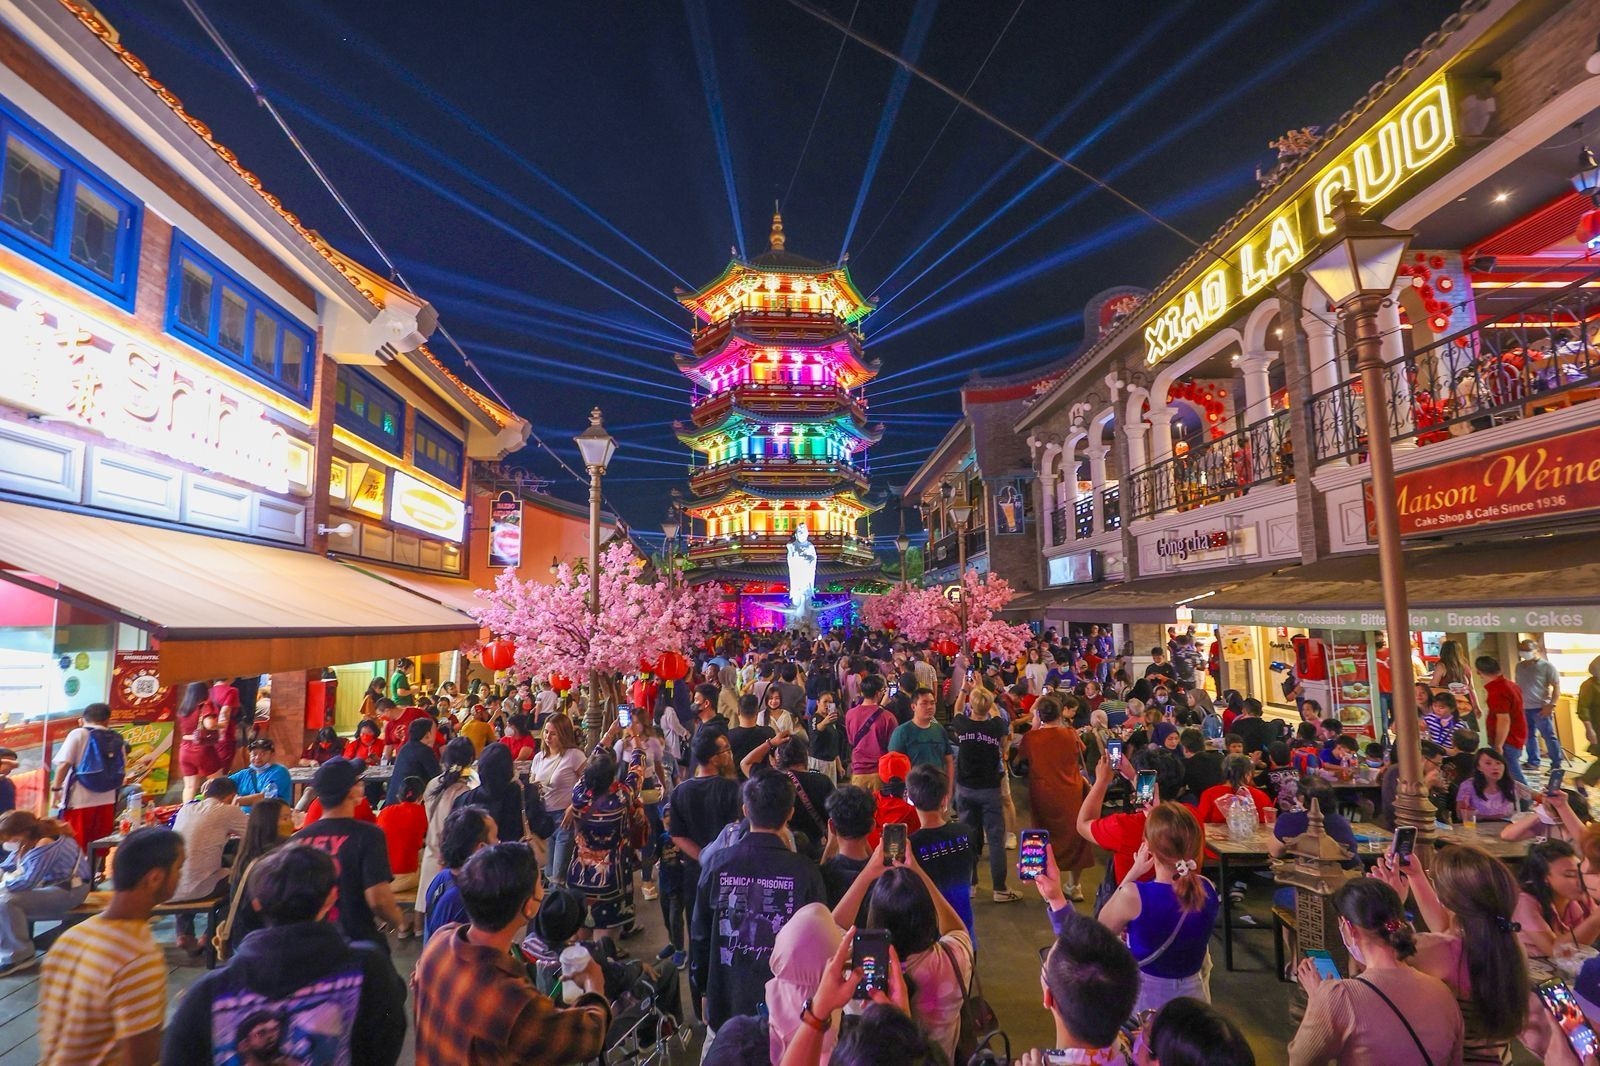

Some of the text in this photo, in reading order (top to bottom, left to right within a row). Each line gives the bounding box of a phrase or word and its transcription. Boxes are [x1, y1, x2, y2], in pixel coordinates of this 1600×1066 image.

[1145, 269, 1226, 364] XIAO
[1240, 217, 1299, 297] LA
[1414, 516, 1438, 528] Cake
[1438, 513, 1464, 524] Shop
[1465, 510, 1474, 519] &
[1500, 501, 1534, 514] Since
[1535, 495, 1566, 509] 1936
[1157, 538, 1188, 560] Gong
[1187, 530, 1211, 552] cha
[1296, 613, 1346, 625] Croissants
[1447, 612, 1500, 626] Breads
[1525, 611, 1584, 626] Cakes
